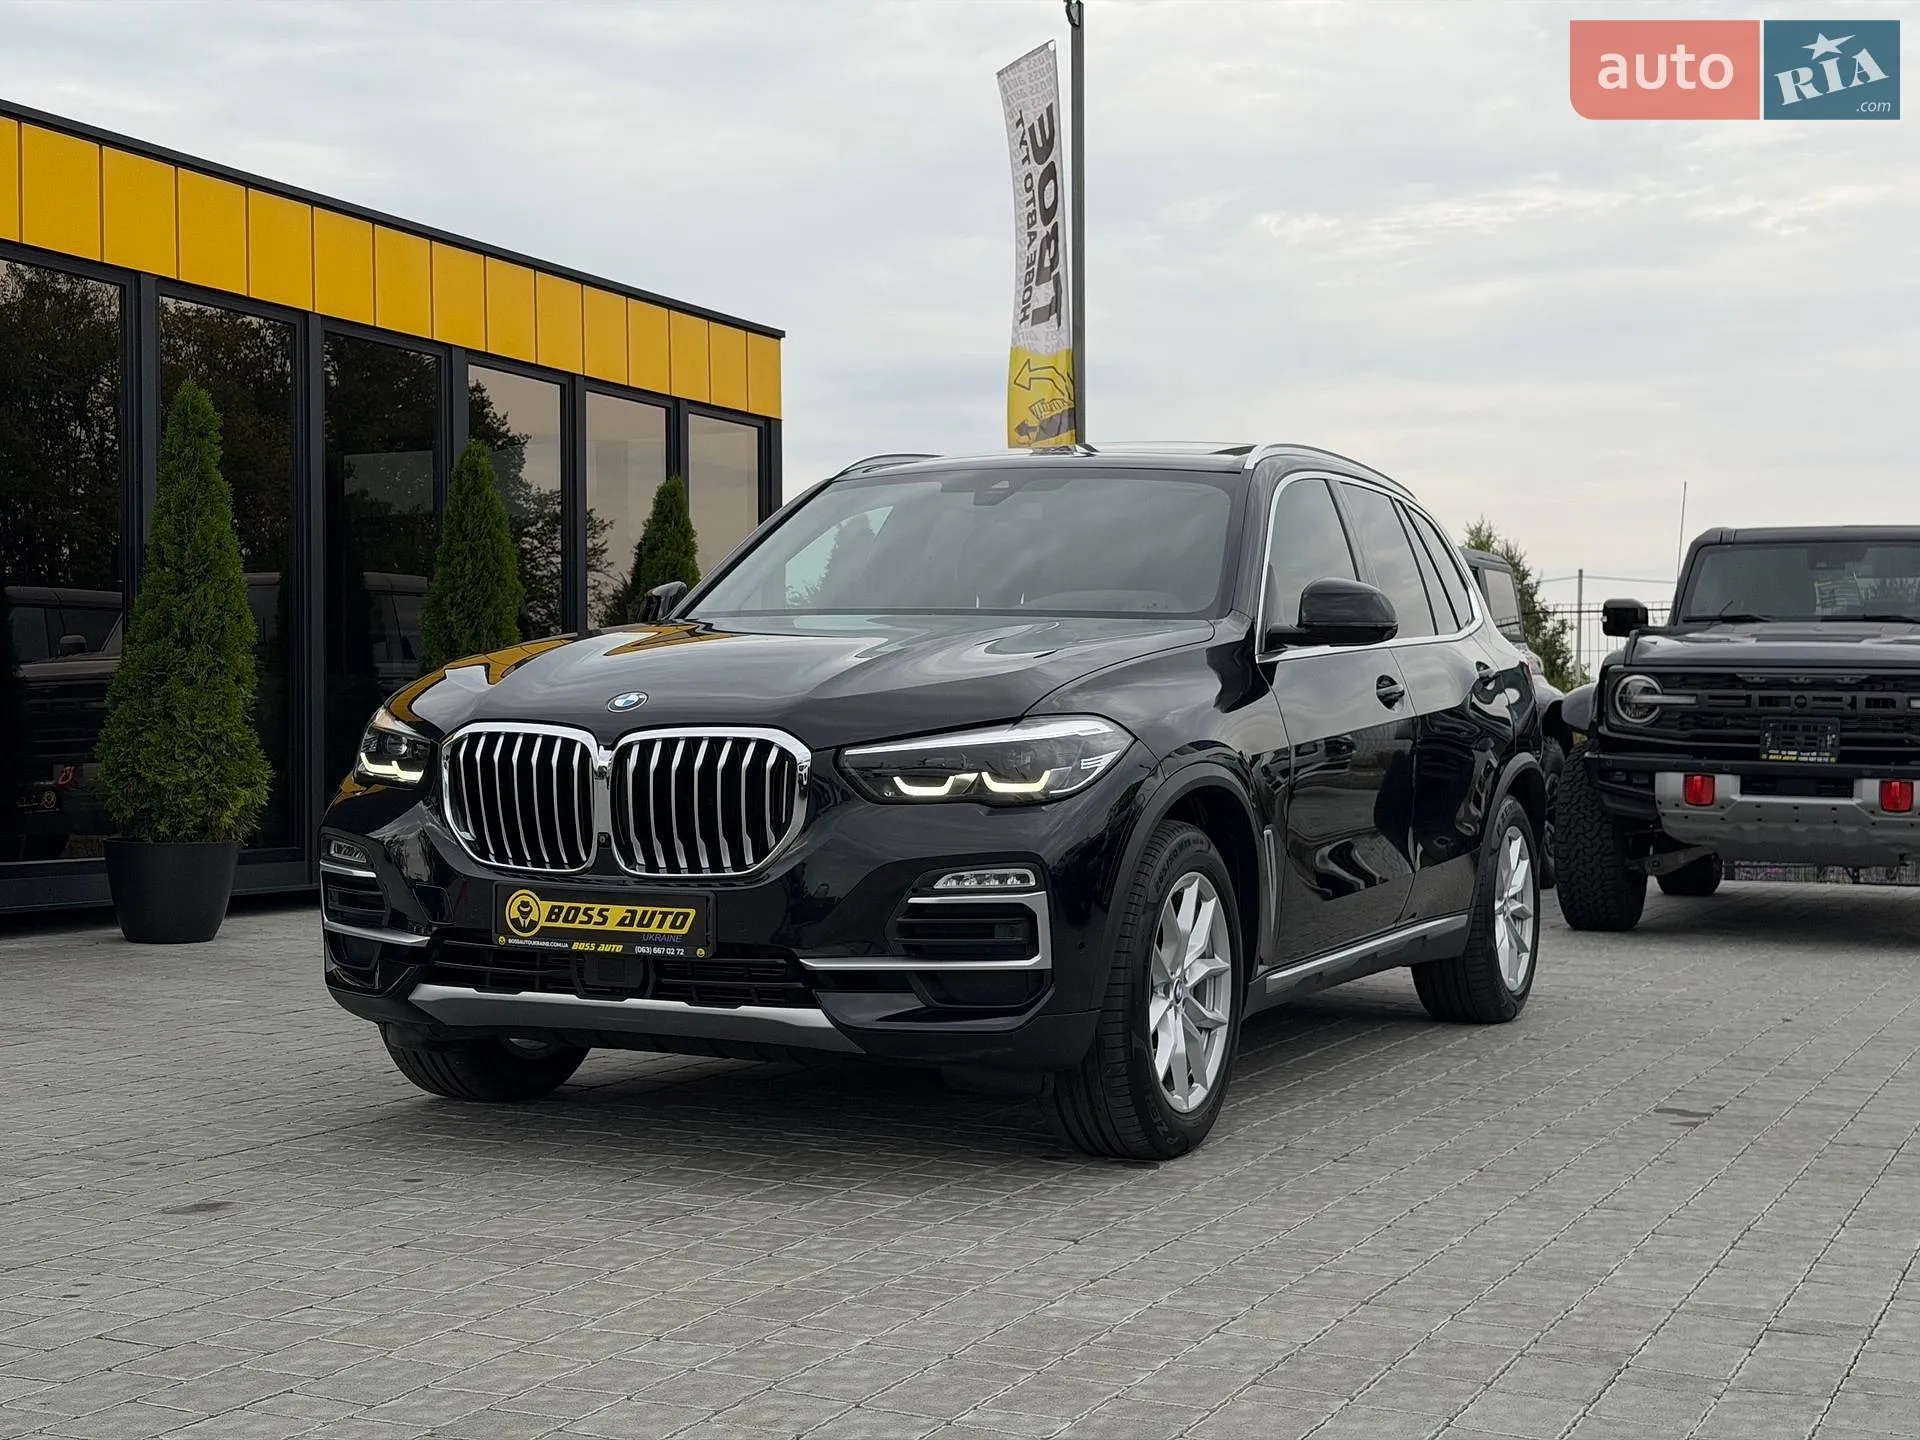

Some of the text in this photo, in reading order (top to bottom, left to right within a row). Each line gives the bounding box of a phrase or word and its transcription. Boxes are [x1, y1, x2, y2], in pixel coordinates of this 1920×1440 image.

[544, 904, 691, 930] BOSS AUTO
[642, 933, 683, 943] UKRAINE
[571, 942, 624, 953] BOSS AUTO
[634, 945, 685, 956] (063) 667 02 72
